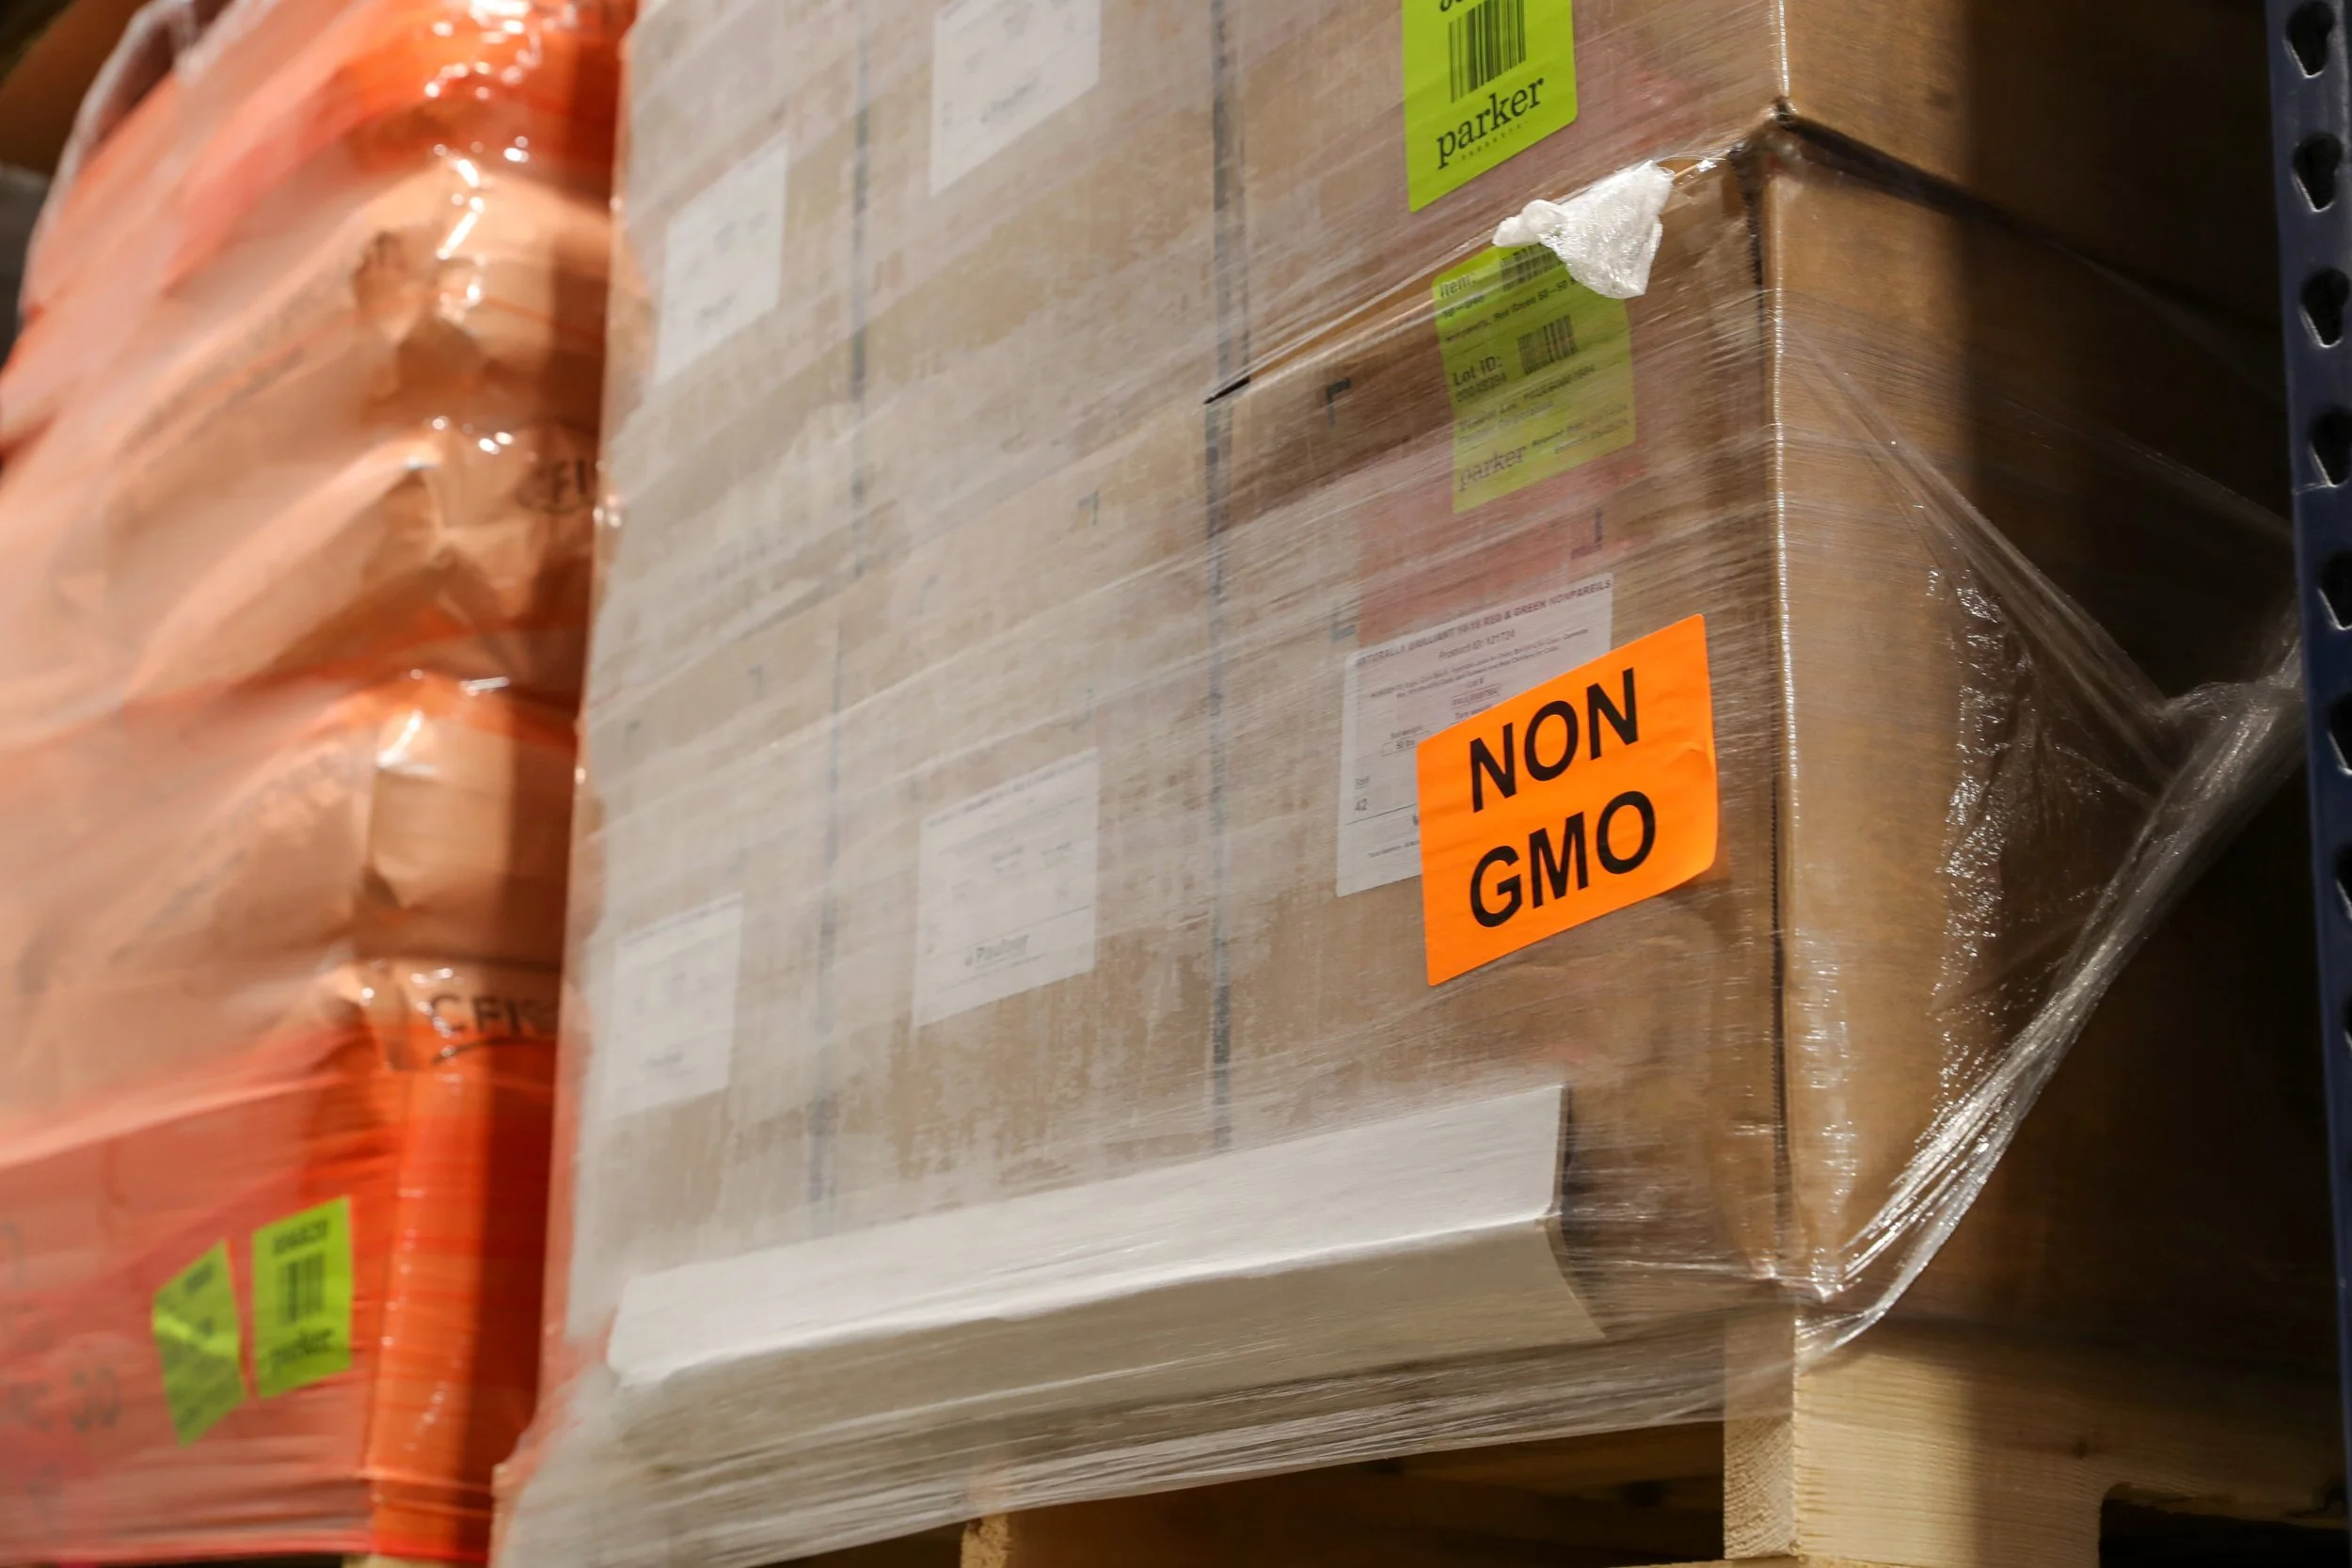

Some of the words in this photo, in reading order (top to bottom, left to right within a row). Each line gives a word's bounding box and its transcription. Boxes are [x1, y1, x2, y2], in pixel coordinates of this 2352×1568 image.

[1436, 77, 1544, 170] parker
[1453, 366, 1476, 386] Lot
[1458, 445, 1527, 493] parker
[1513, 599, 1546, 617] GREEN
[1469, 667, 1639, 815] NON
[1470, 790, 1656, 927] GMO
